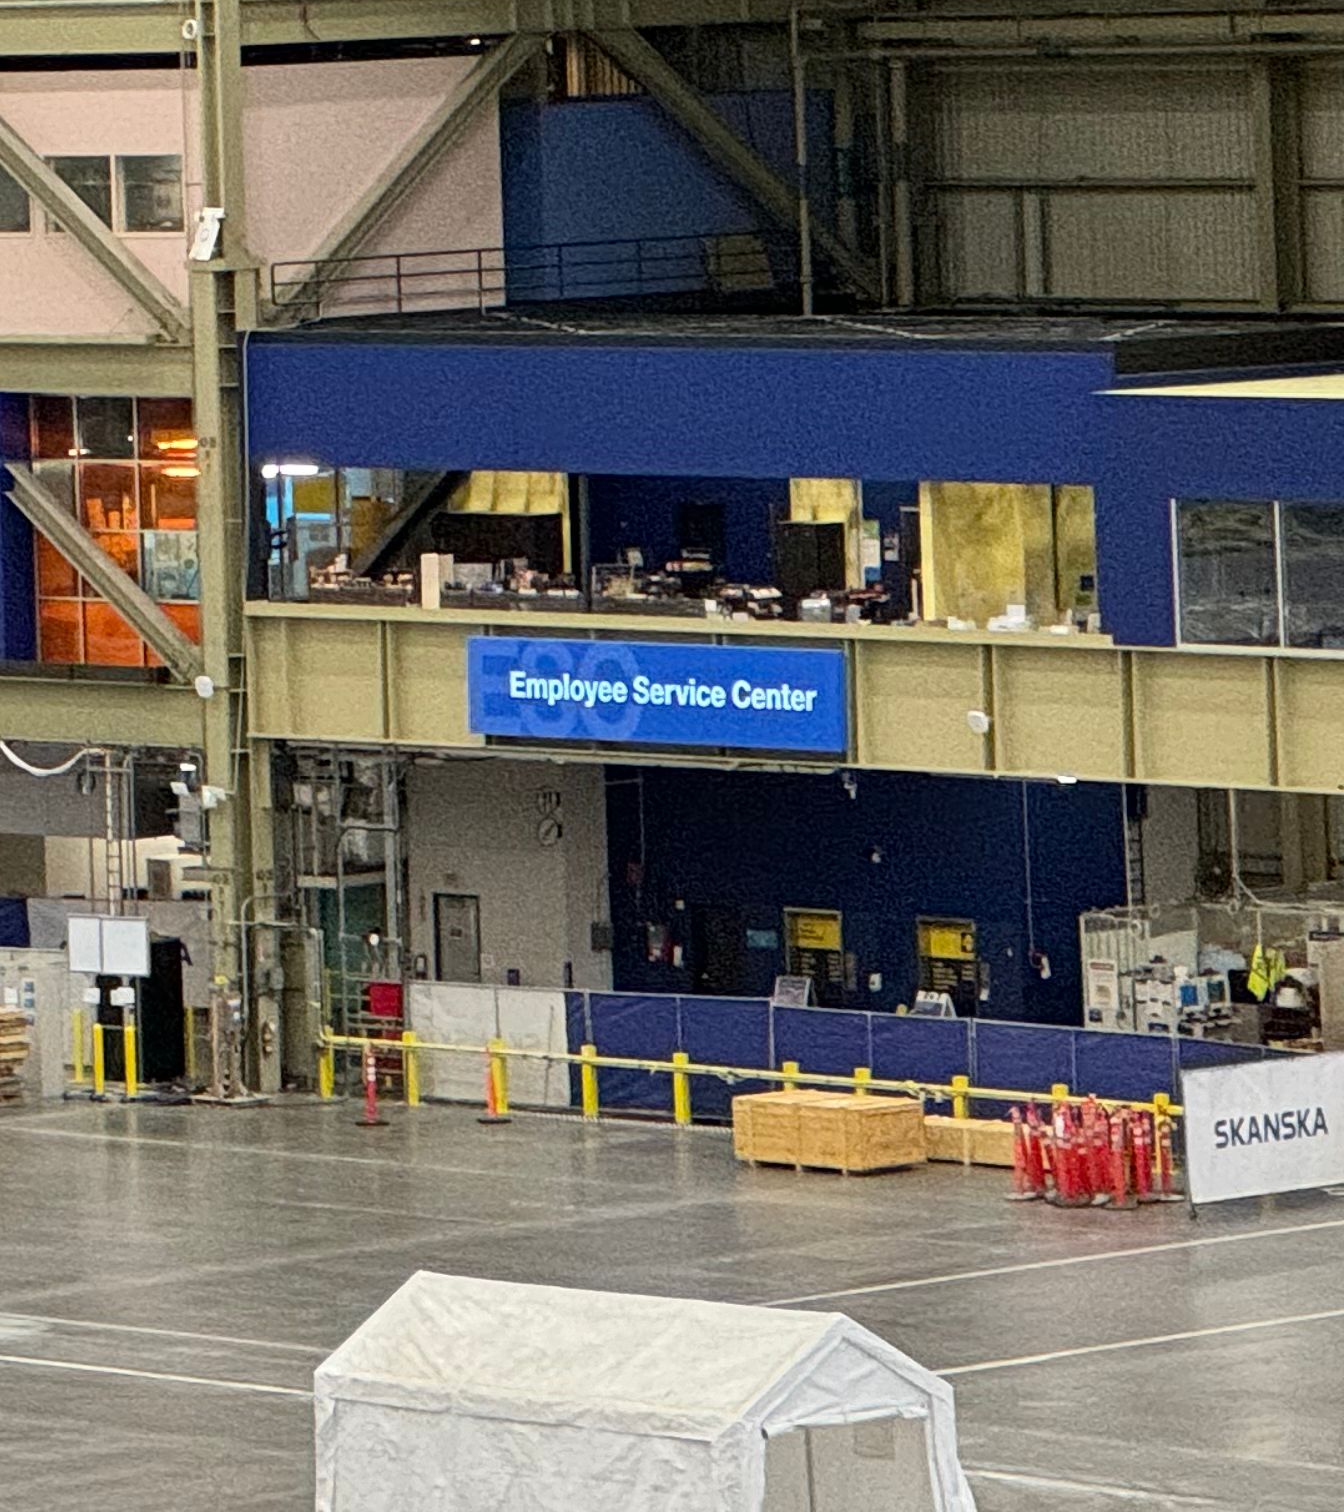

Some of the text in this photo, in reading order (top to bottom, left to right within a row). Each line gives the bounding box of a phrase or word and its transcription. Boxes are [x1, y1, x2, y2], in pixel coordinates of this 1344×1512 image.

[509, 670, 818, 712] Employee Service Center
[1214, 1106, 1328, 1149] SKANSKA
